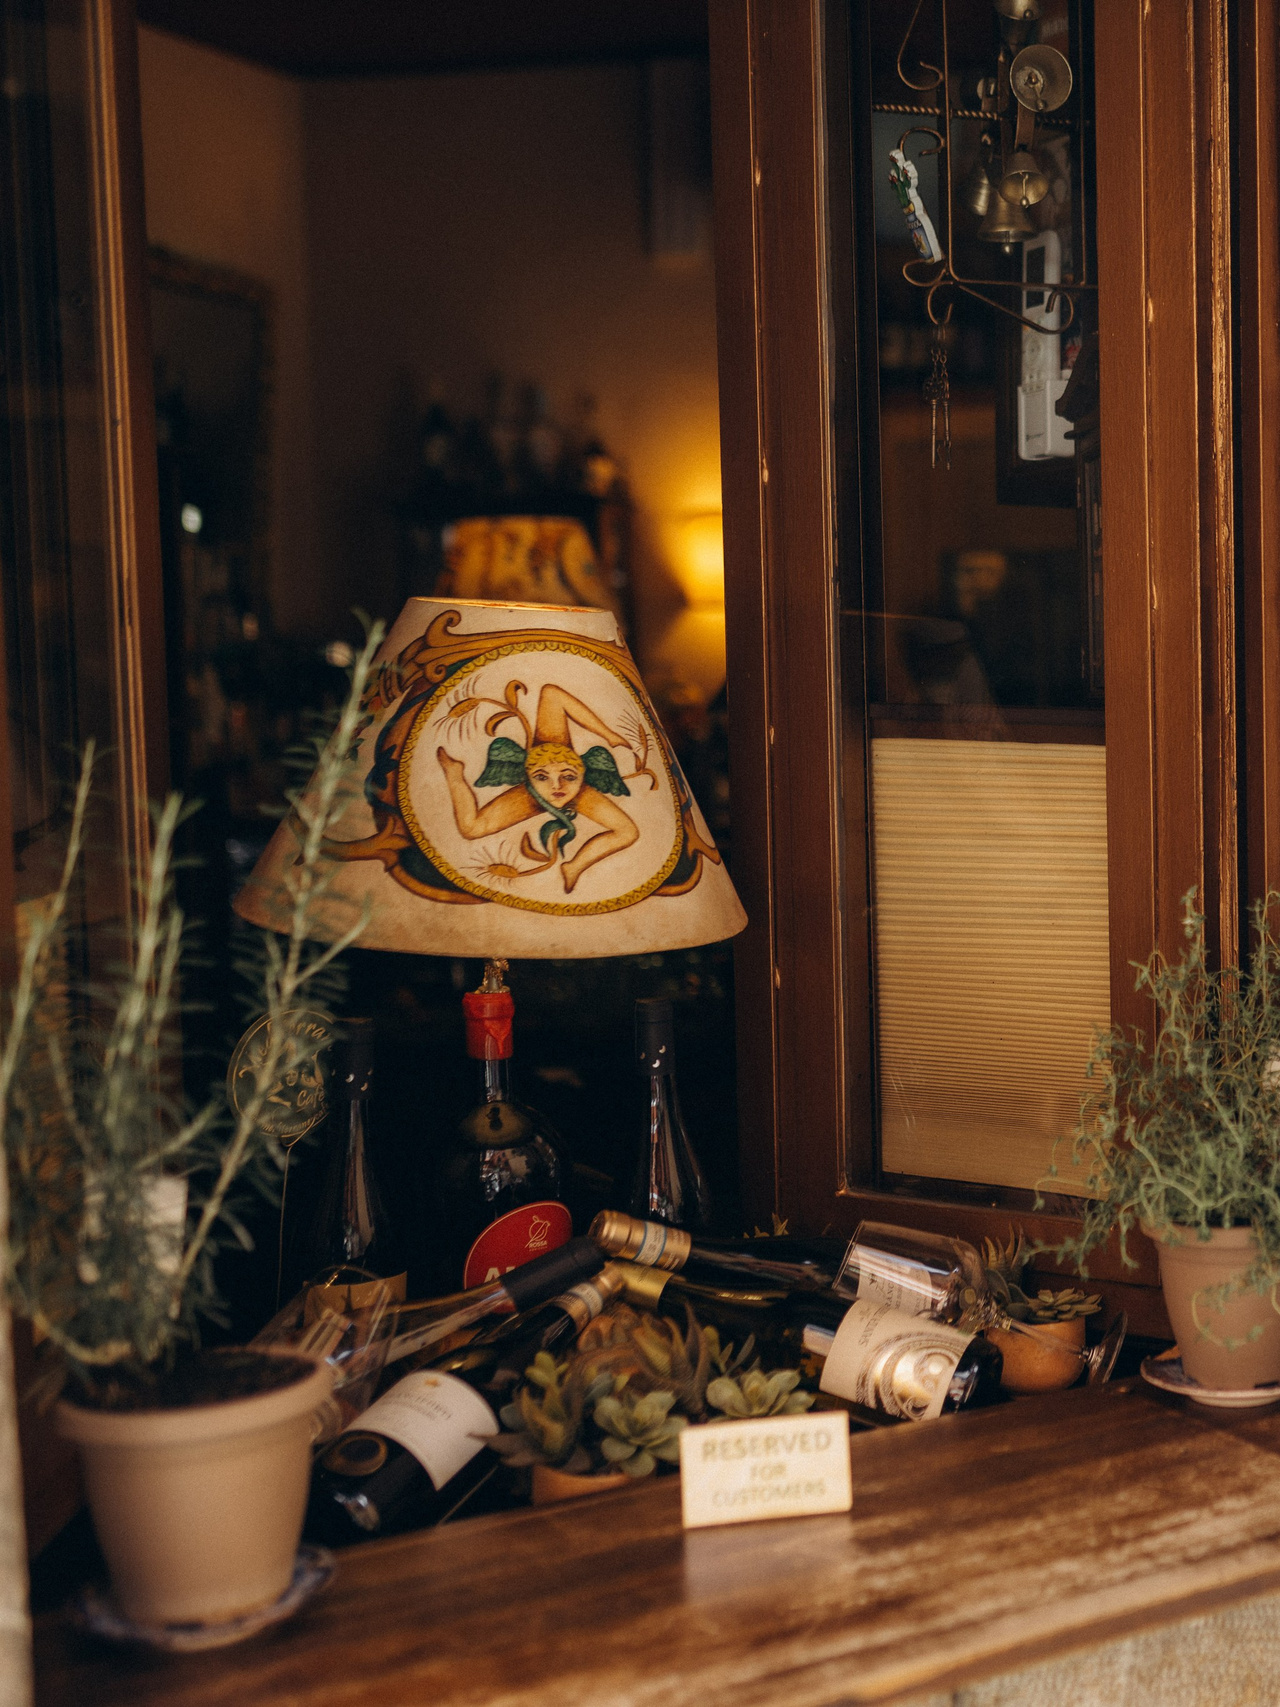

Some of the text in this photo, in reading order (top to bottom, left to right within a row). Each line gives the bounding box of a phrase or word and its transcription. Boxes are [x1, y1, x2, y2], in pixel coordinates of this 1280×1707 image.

[702, 1428, 832, 1463] RESERVED
[750, 1462, 787, 1481] FOR
[712, 1479, 827, 1507] CUSTOMERS
